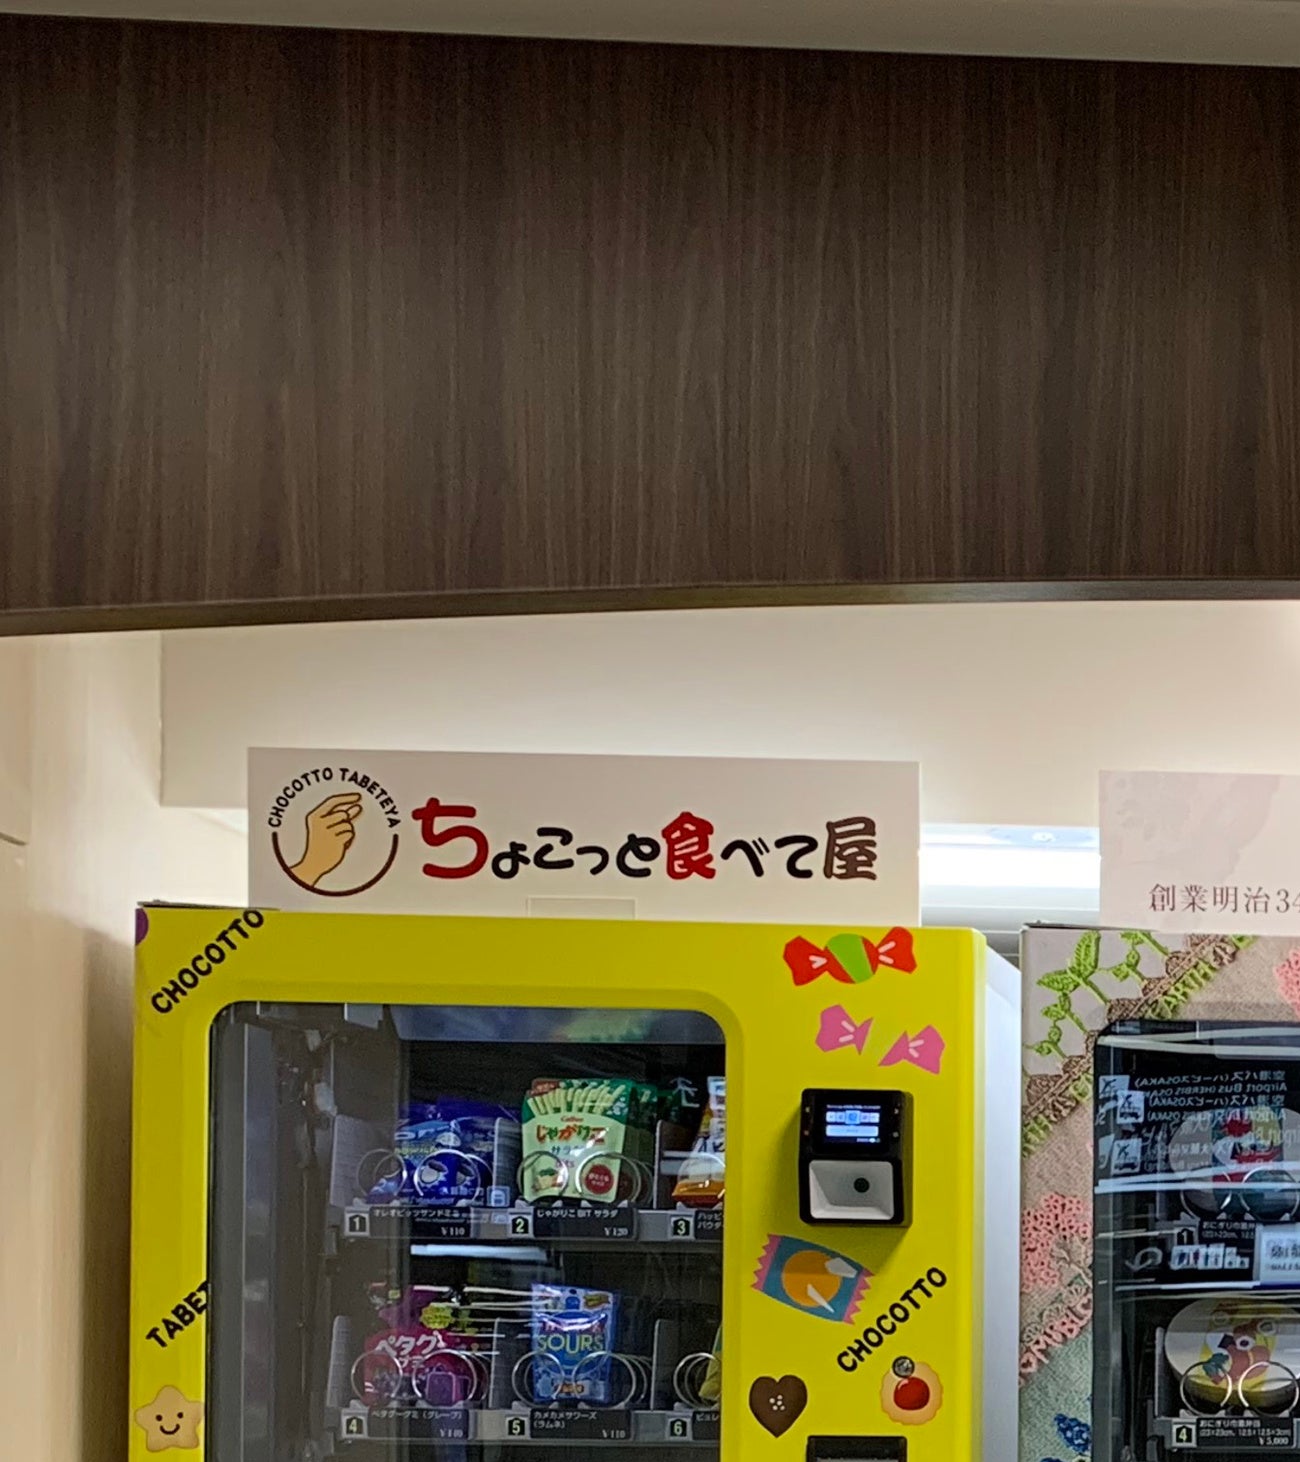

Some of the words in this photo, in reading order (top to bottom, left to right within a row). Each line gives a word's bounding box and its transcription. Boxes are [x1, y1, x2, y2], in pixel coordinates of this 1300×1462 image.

[266, 767, 334, 829] CHOCOTTO
[338, 767, 401, 829] TABETEYA
[411, 797, 878, 880] ちょこっと食べて屋
[150, 908, 265, 1015] CHOCOTTO
[535, 1123, 609, 1146] じゃがりこ
[515, 1215, 525, 1233] 2
[677, 1217, 686, 1233] 3
[836, 1265, 948, 1374] CHOCOTTO
[536, 1333, 606, 1352] SOURS
[511, 1417, 521, 1434] 5
[673, 1418, 683, 1435] 6
[1178, 1429, 1188, 1443] 4
